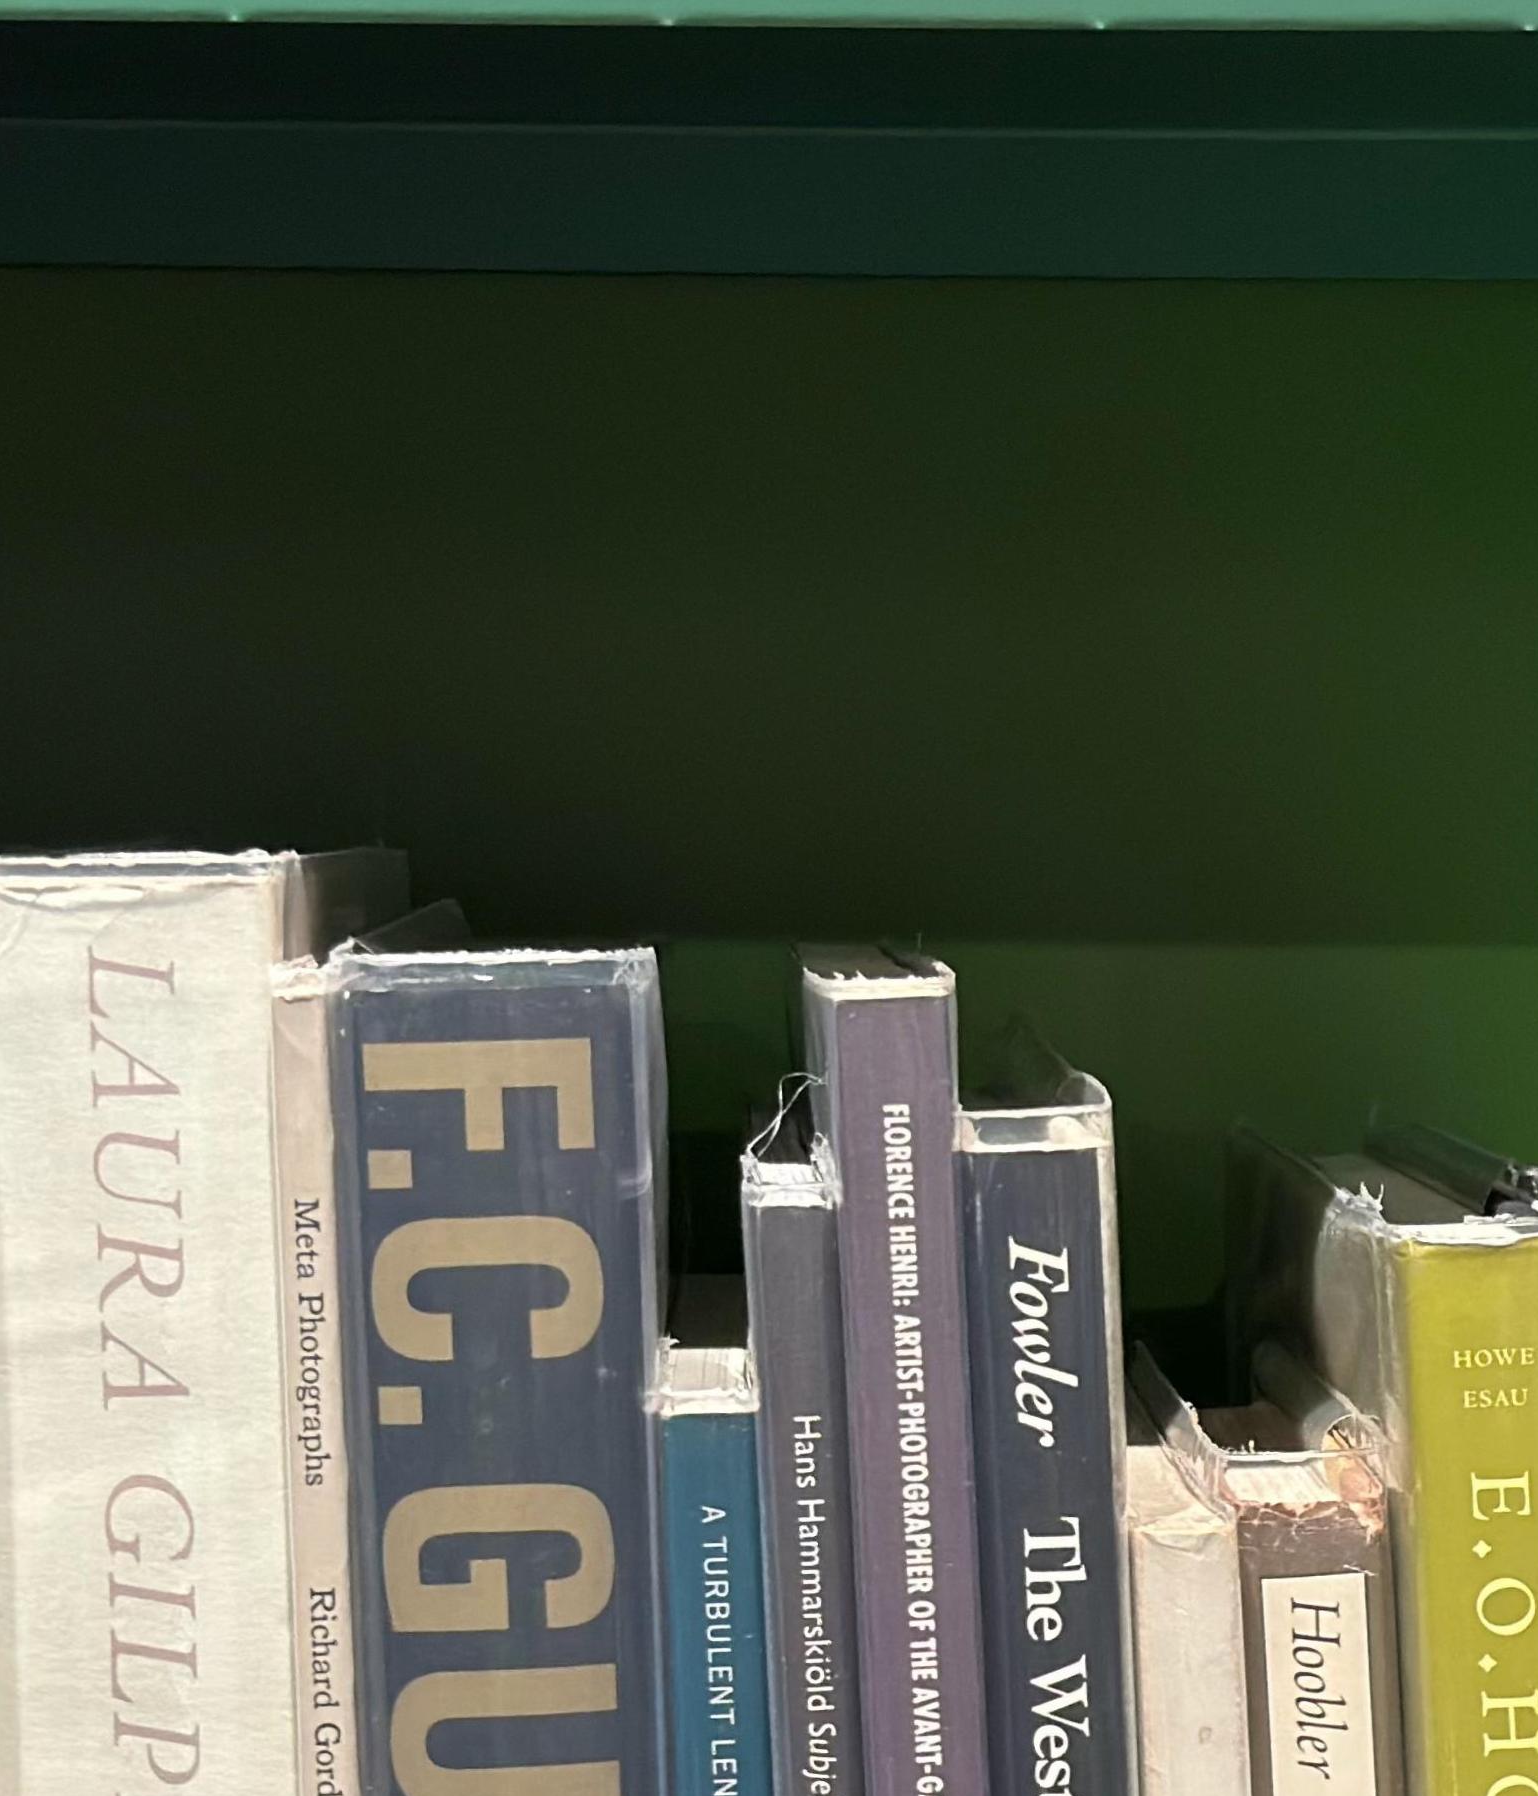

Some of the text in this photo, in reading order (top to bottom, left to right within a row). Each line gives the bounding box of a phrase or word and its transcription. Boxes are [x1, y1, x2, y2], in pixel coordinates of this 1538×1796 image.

[87, 945, 192, 1411] LAURA
[881, 1104, 915, 1218] FLORENCE
[360, 1036, 604, 1425] F.C.
[889, 1225, 917, 1307] HENRI:
[292, 1198, 324, 1489] Meta Photographs
[1007, 1236, 1079, 1448] Fowler
[1452, 1346, 1537, 1370] HOWE
[1462, 1386, 1530, 1410] ESAU
[792, 1414, 817, 1488] Hans
[892, 1315, 934, 1595] ARTIST-PHOTOGRAPHER
[701, 1505, 725, 1523] A
[703, 1534, 735, 1726] TURBULENT
[797, 1499, 835, 1713] Hammarskiöld
[907, 1600, 936, 1630] OF
[1024, 1517, 1087, 1641] The
[307, 1587, 337, 1709] Richard
[910, 1634, 939, 1679] THE
[1289, 1596, 1350, 1780] Hoobler
